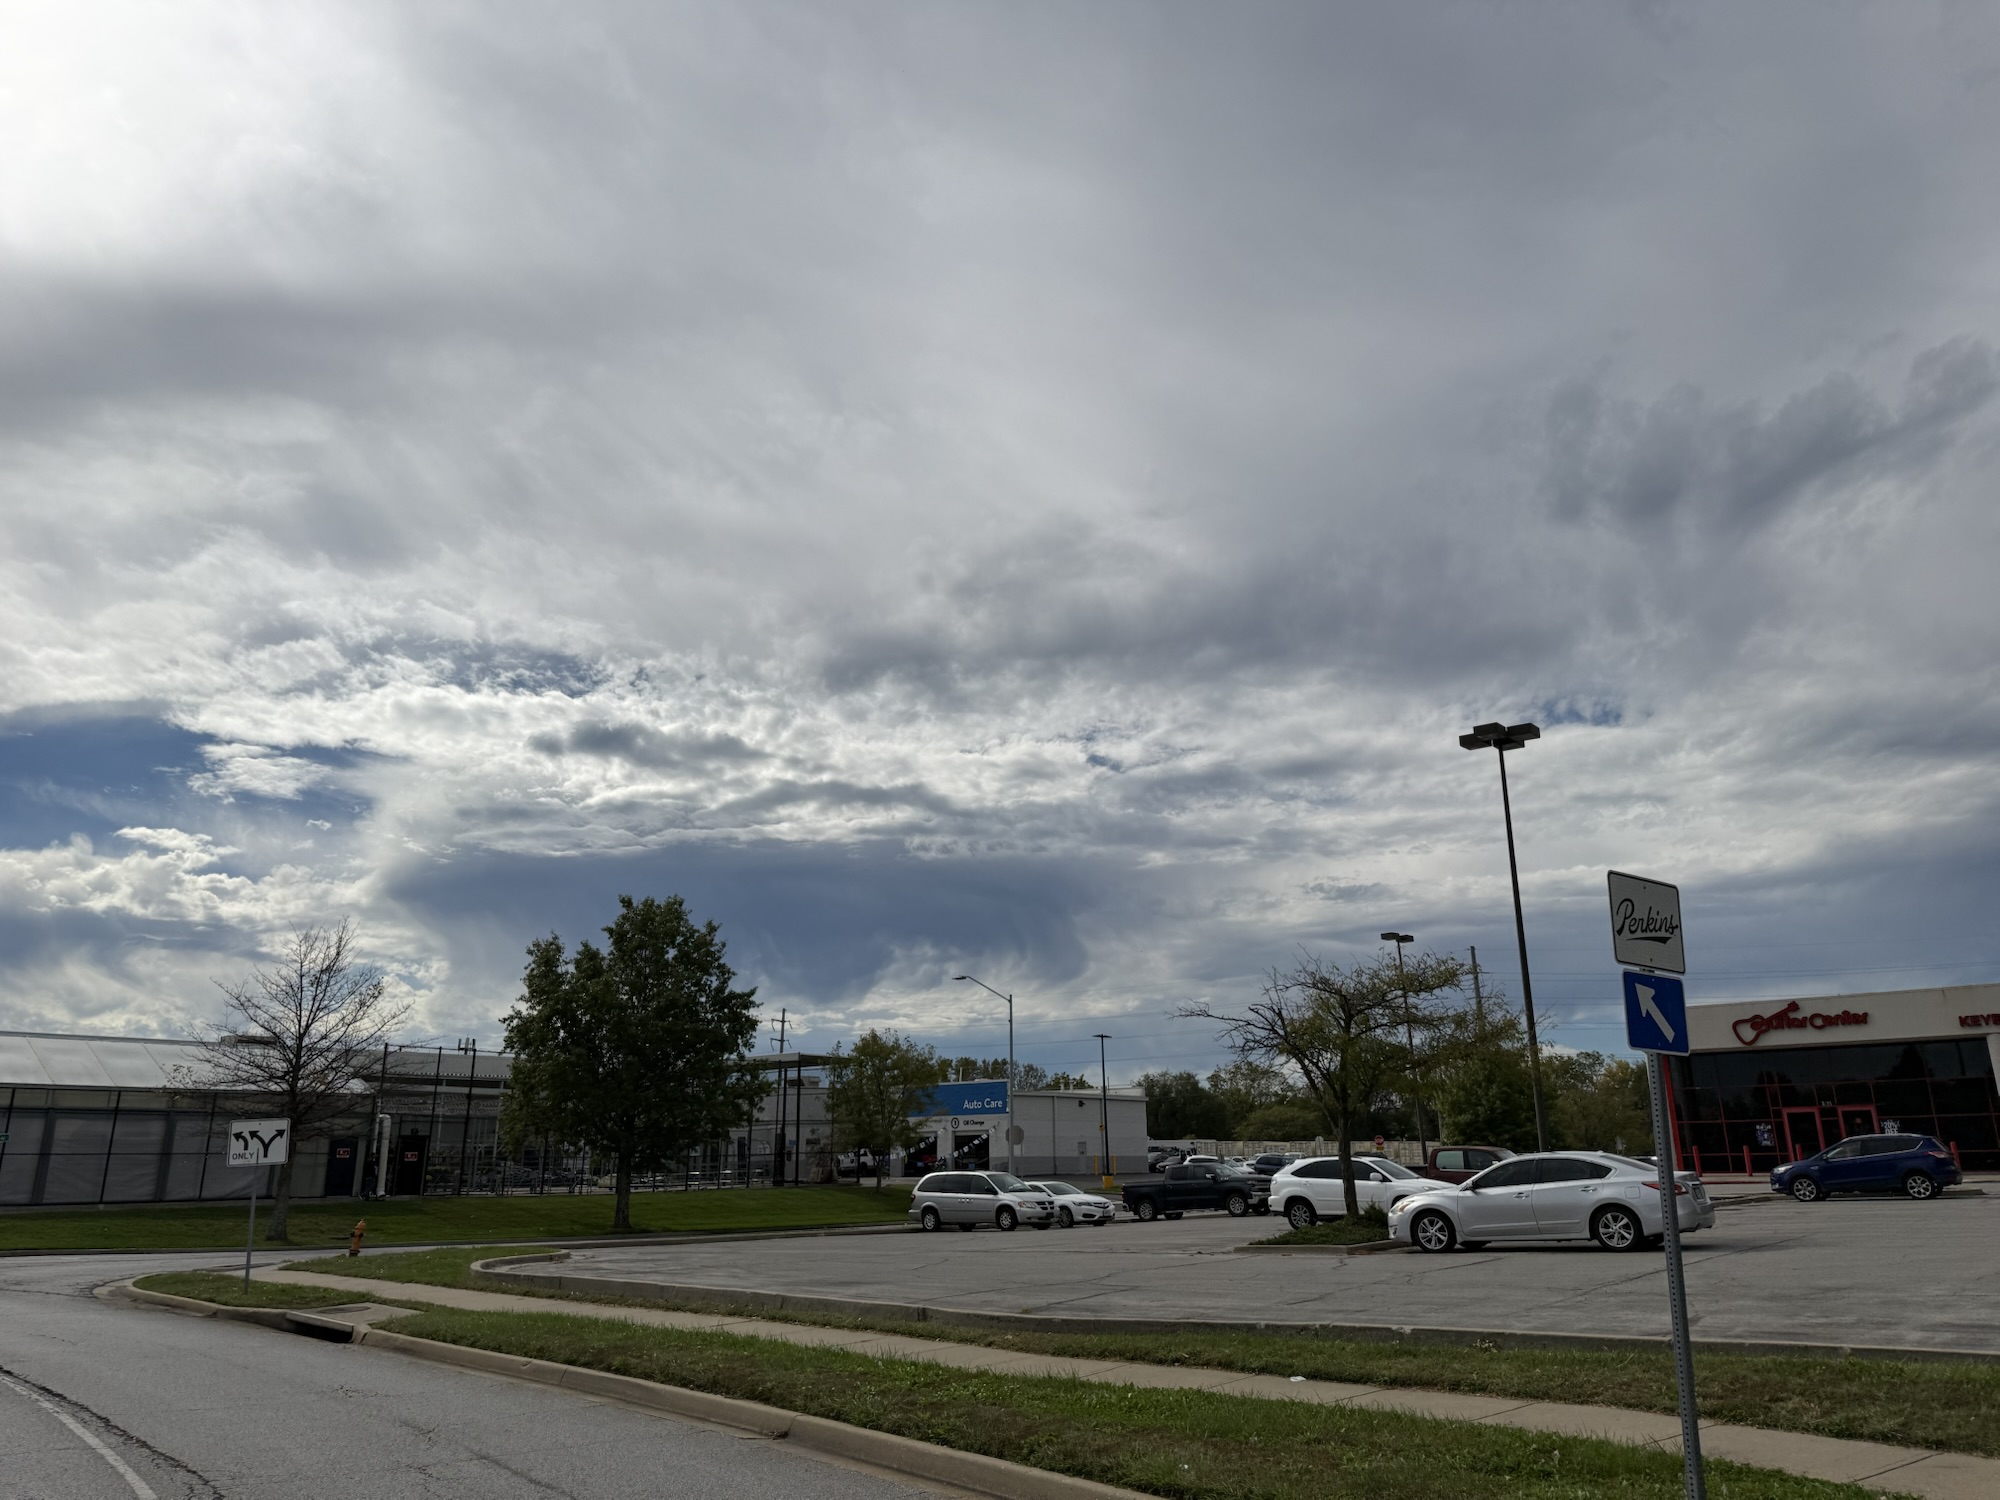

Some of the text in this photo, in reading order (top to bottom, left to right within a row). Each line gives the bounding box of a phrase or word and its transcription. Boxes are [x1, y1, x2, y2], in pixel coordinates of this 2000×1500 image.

[1615, 898, 1679, 936] Perkins
[1809, 1010, 1868, 1029] Center
[963, 1098, 1002, 1109] Auto Care
[232, 1152, 254, 1160] ONLY
